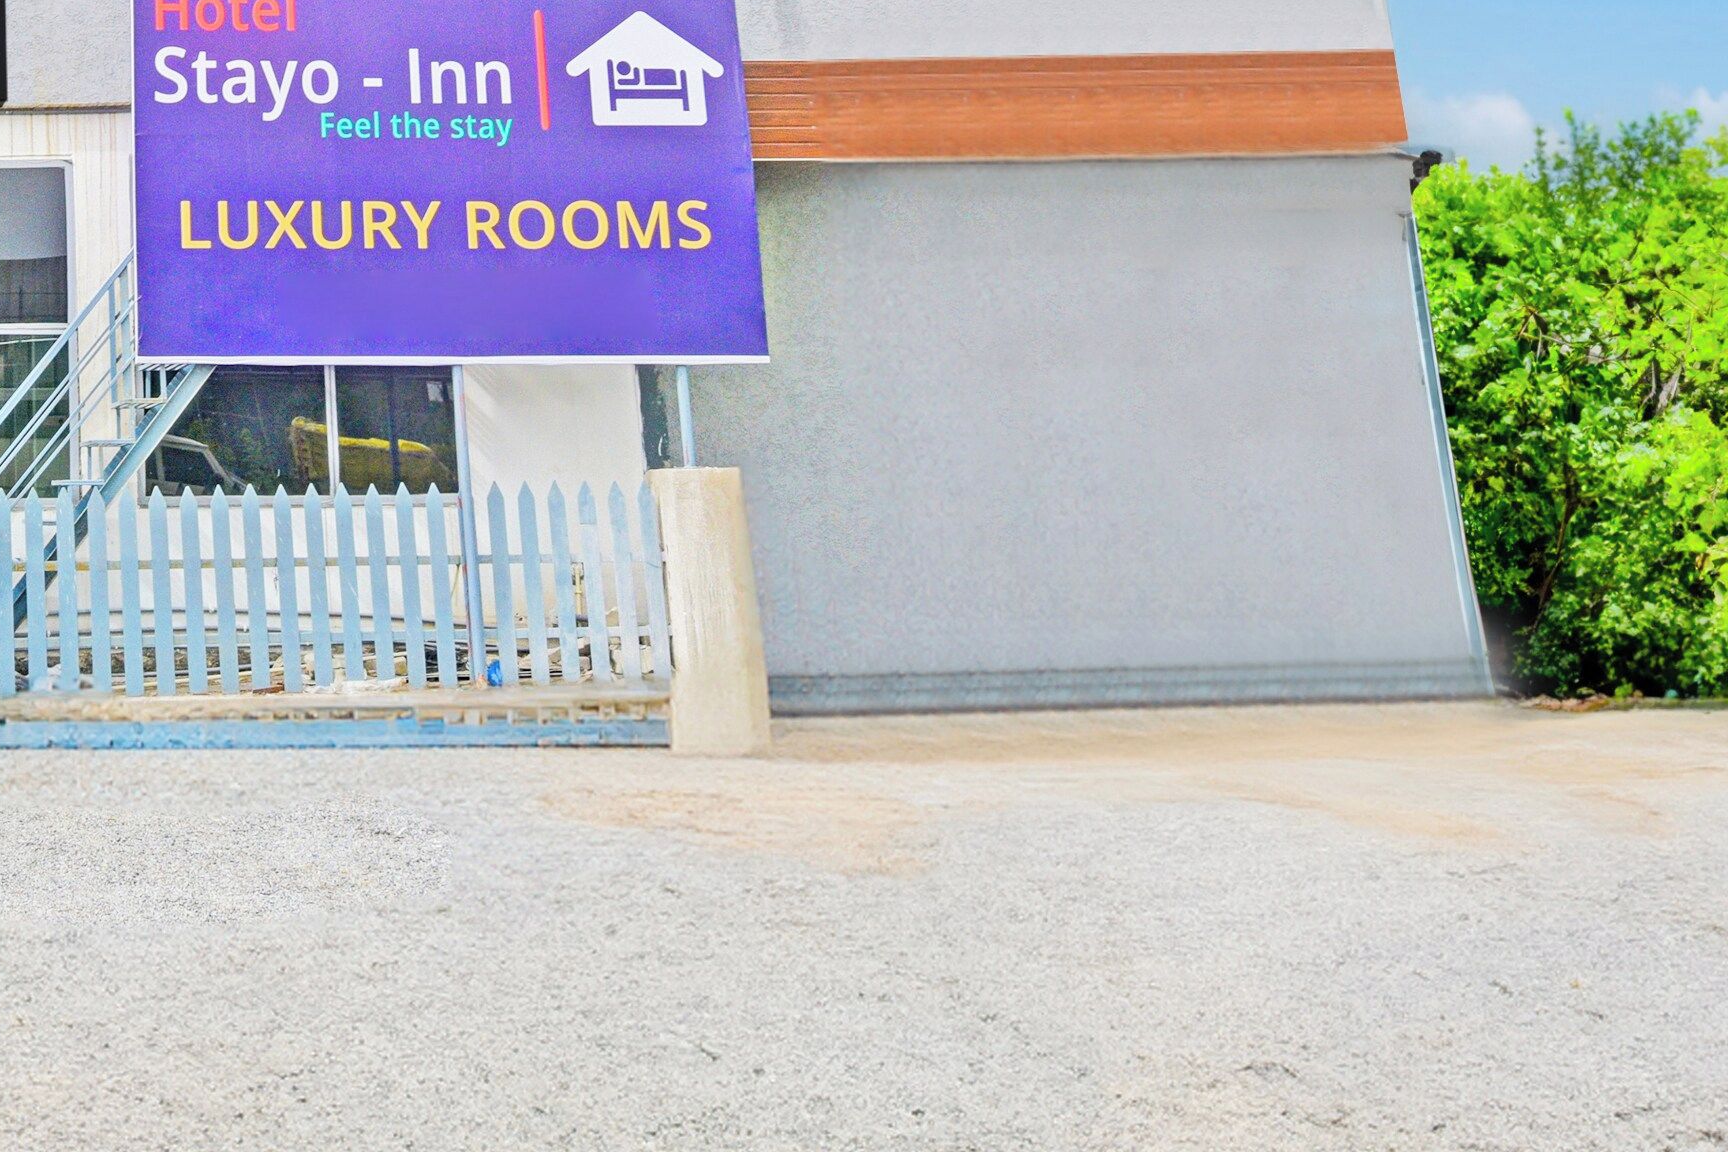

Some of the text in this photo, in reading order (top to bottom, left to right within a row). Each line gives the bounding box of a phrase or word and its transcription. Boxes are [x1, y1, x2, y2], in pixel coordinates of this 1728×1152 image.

[153, 46, 340, 122] Stayo
[407, 47, 513, 105] Inn
[319, 111, 514, 147] Feel the stay
[179, 201, 712, 249] LUXURY ROOMS
